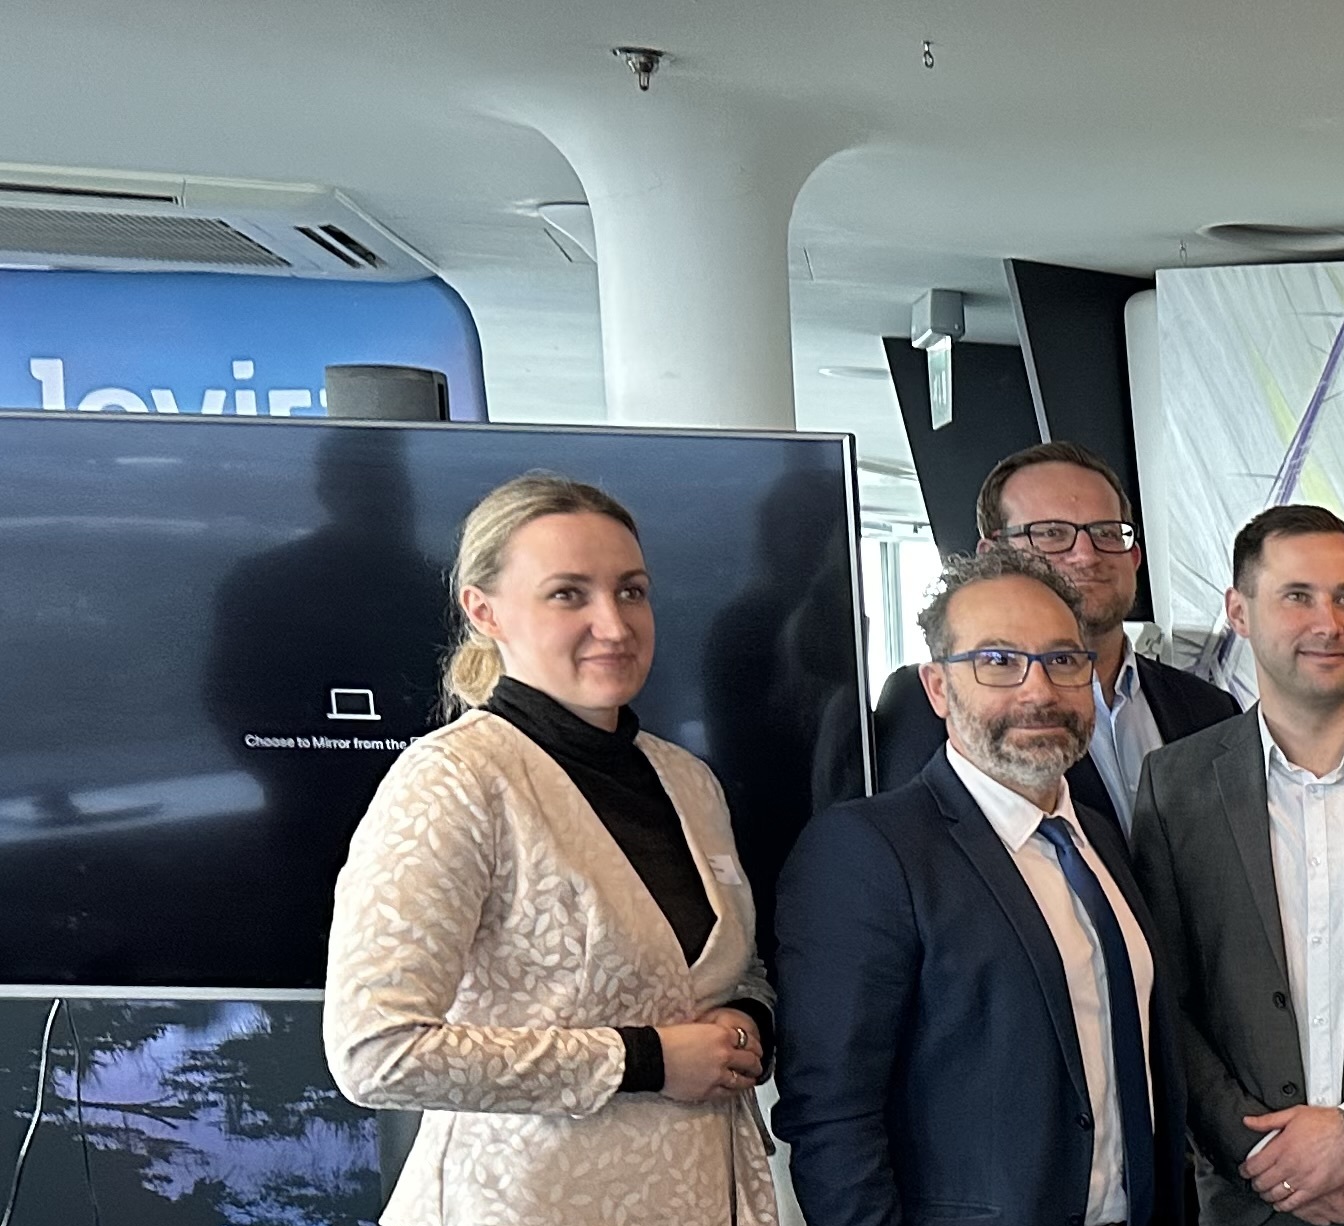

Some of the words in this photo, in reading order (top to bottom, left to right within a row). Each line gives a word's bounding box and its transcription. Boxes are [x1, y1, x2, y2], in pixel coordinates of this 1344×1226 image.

[244, 734, 295, 747] Choose
[297, 736, 311, 748] to
[312, 736, 351, 749] Mirror
[353, 737, 384, 750] from
[385, 738, 408, 750] the
